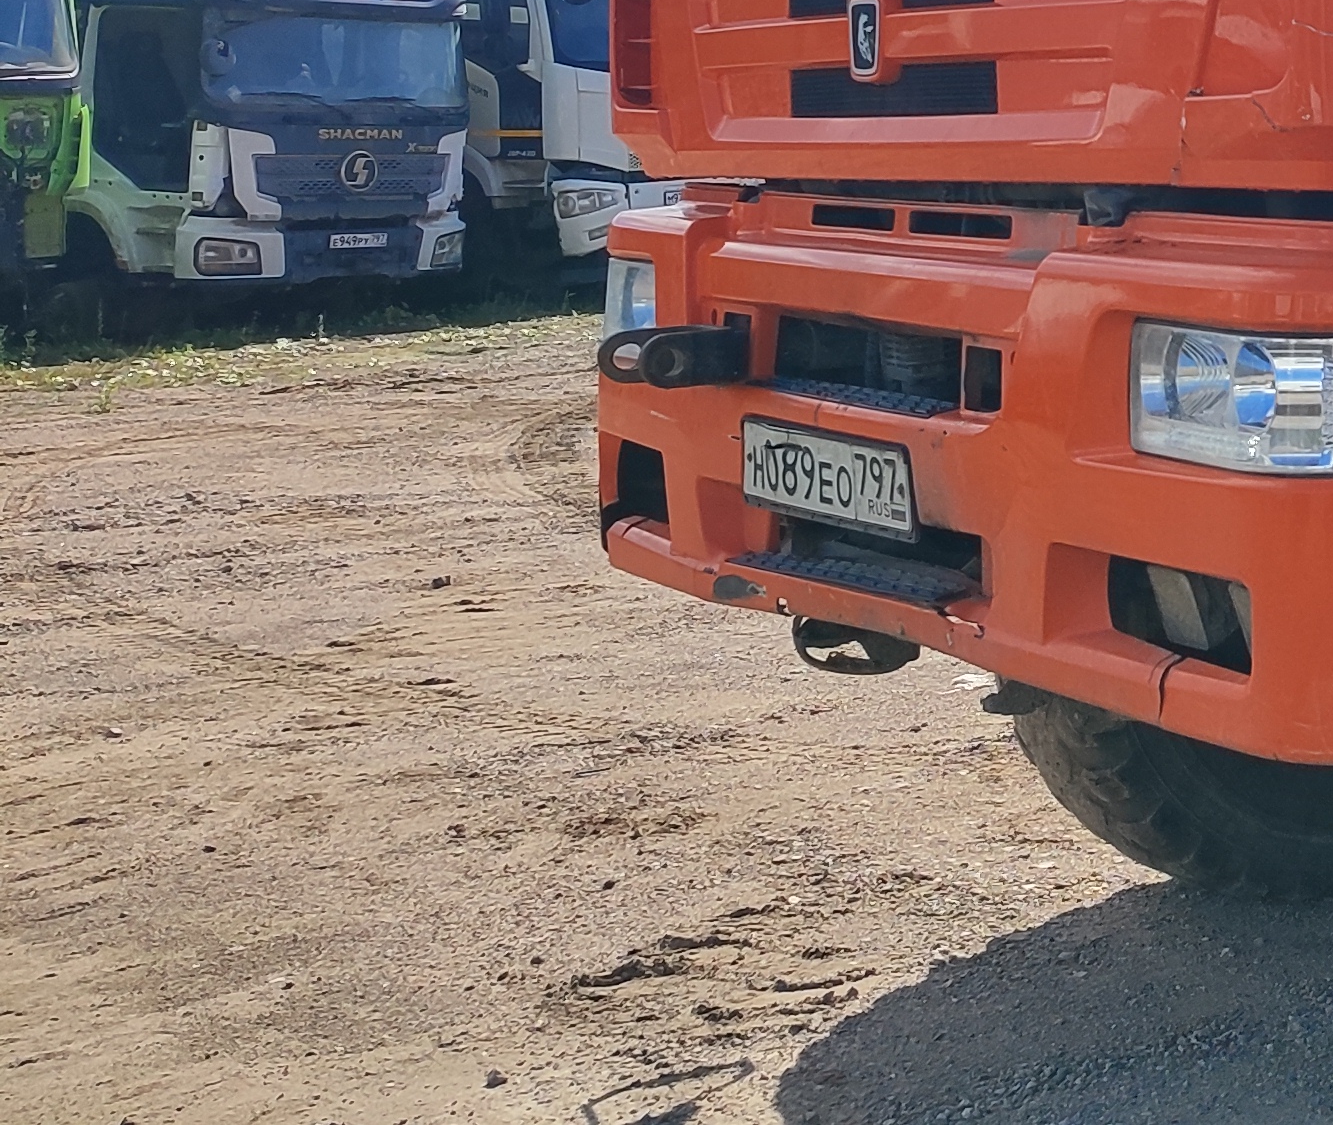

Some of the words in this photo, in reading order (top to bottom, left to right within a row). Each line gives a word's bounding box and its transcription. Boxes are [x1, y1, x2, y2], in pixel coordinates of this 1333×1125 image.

[318, 128, 403, 140] SHACMAN
[854, 453, 897, 503] 797
[867, 498, 891, 518] RUS
